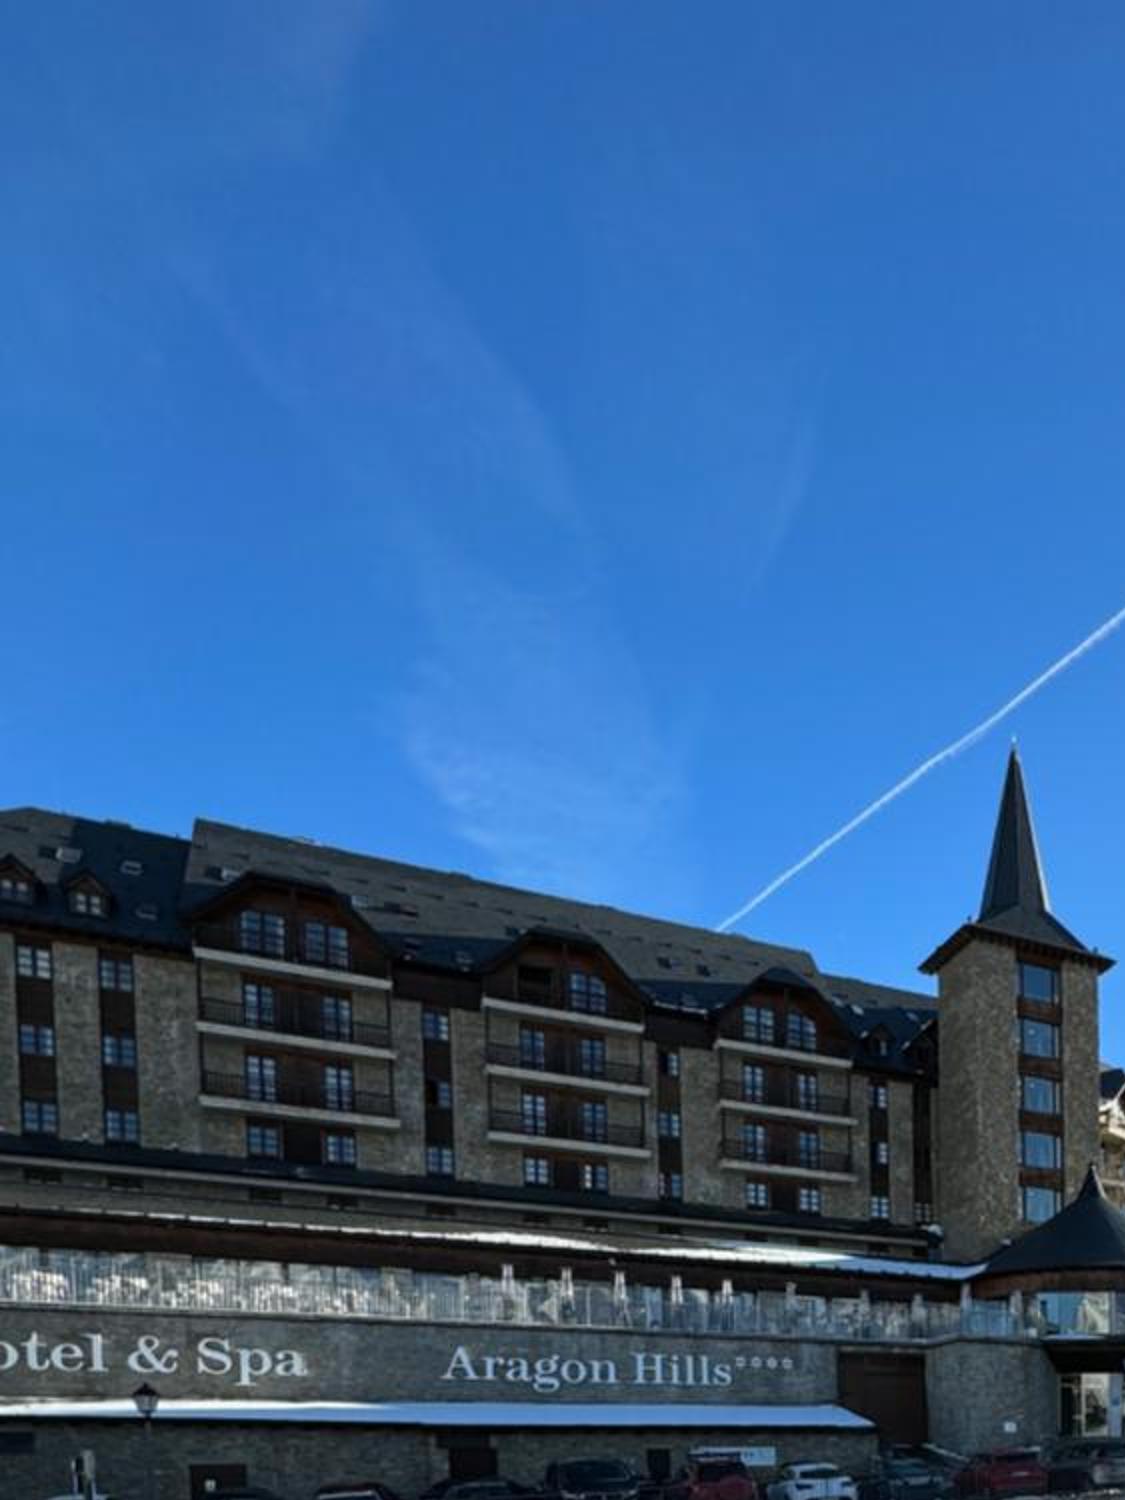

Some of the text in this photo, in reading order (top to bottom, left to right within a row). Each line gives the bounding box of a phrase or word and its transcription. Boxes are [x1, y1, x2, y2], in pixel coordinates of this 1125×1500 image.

[127, 1335, 179, 1374] &
[196, 1337, 309, 1386] Spa
[440, 1346, 733, 1393] Aragon Hills
